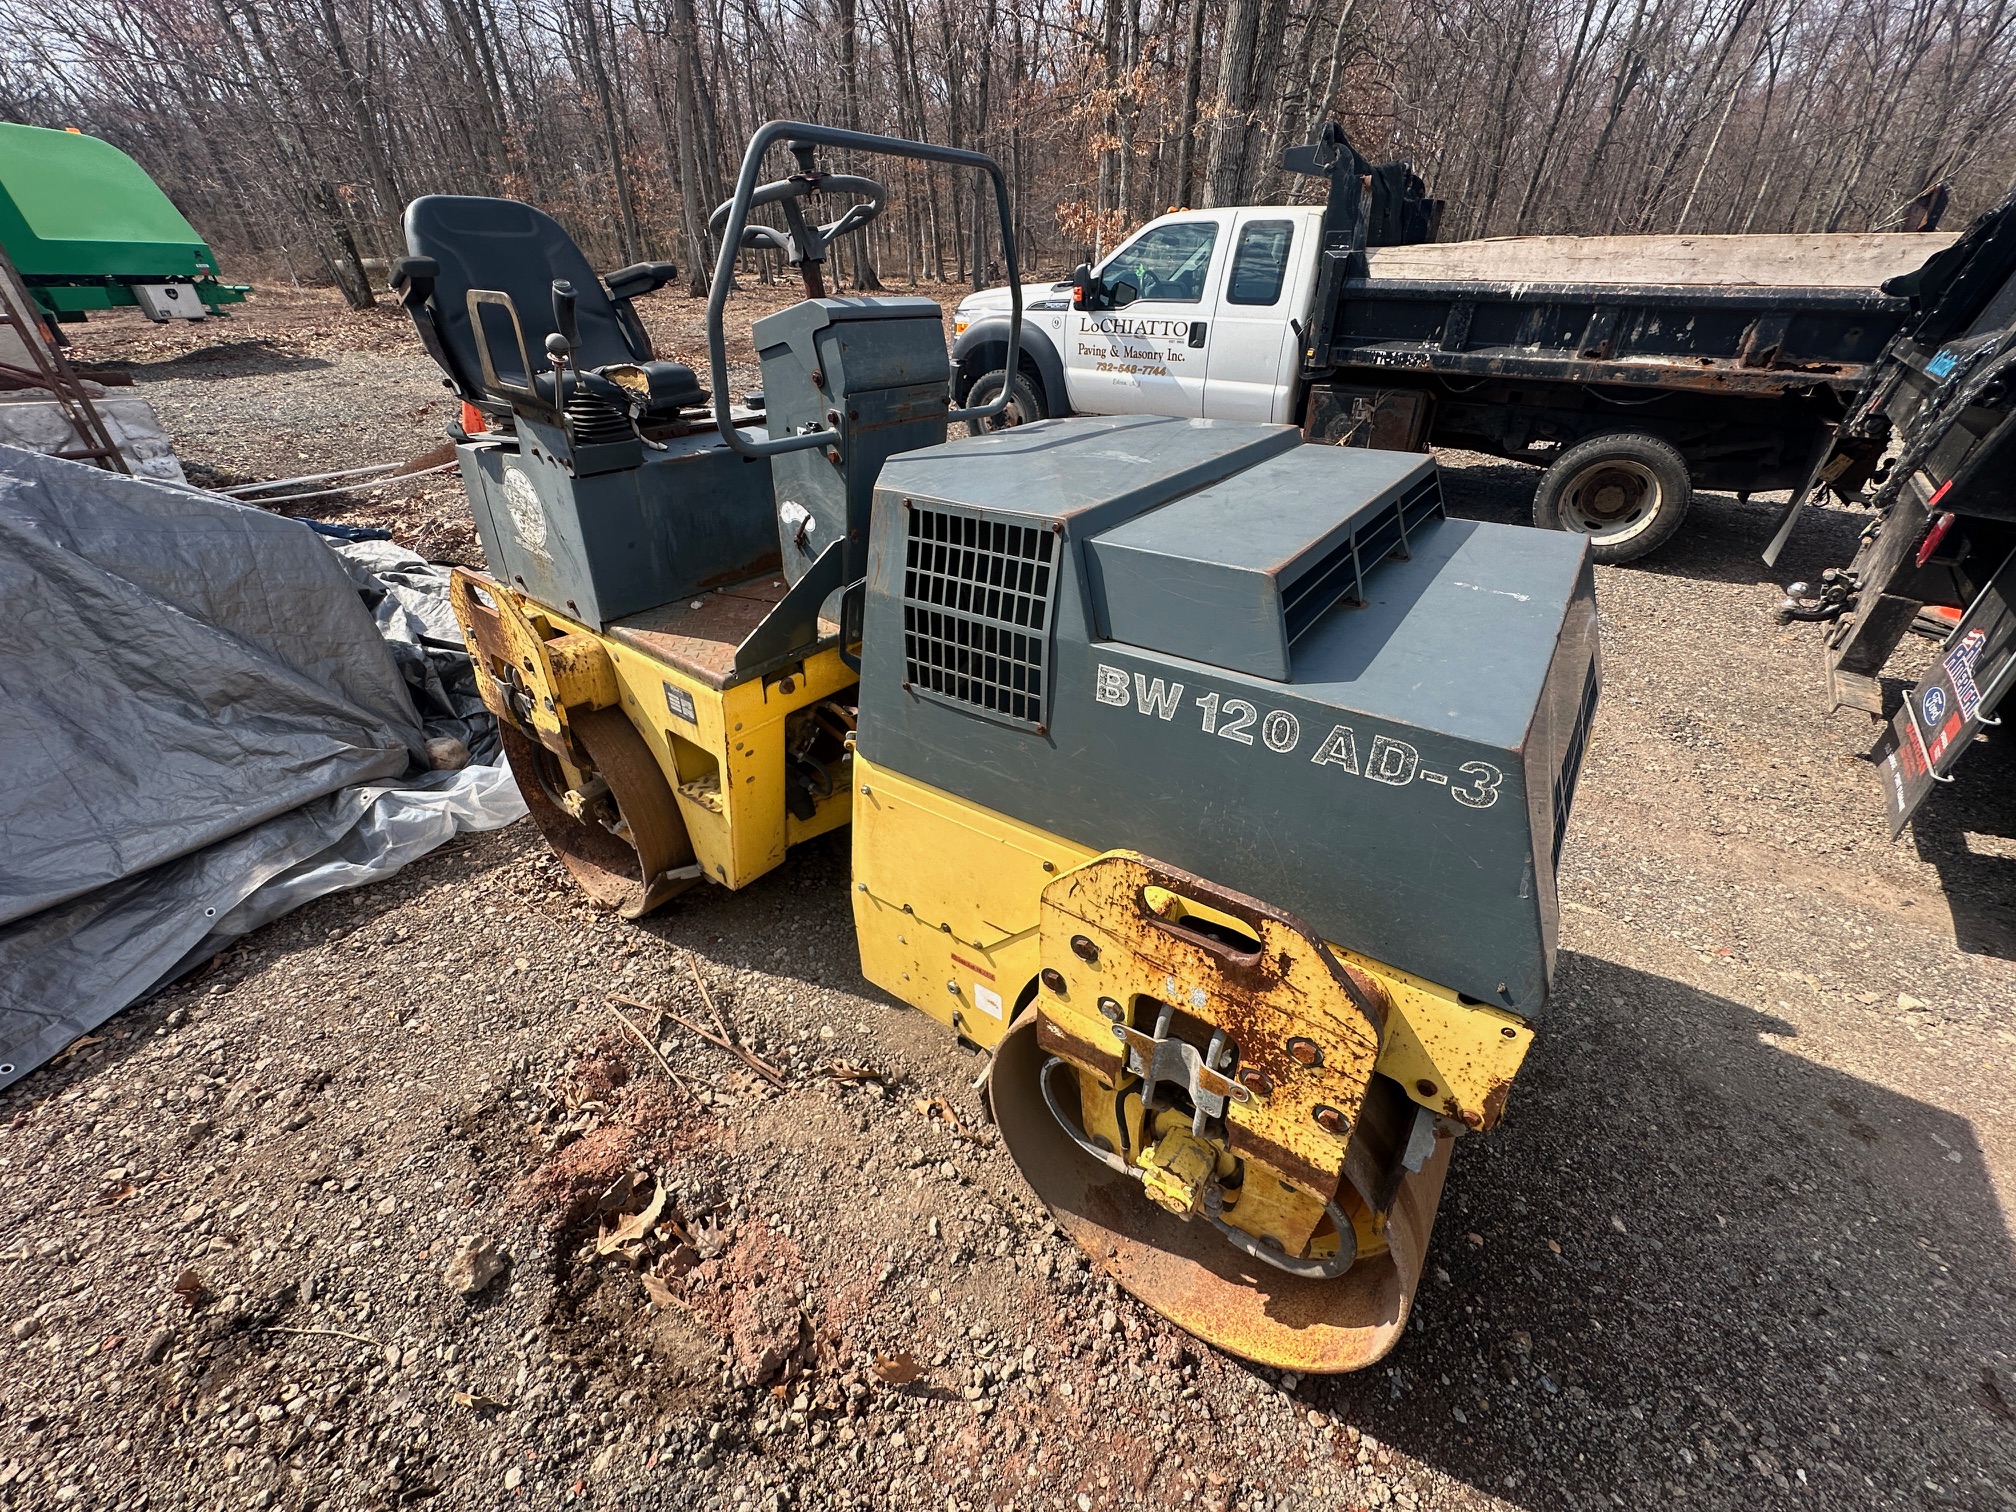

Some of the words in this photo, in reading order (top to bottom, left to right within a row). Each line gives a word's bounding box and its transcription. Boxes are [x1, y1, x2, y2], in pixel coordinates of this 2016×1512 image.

[1080, 318, 1188, 337] LoCHIATTO
[1078, 343, 1107, 359] Paving
[1110, 345, 1120, 358] &
[1124, 346, 1164, 363] Masonry
[1167, 348, 1186, 362] Inc.
[1096, 362, 1167, 376] 732-548-7744
[1925, 691, 1942, 721] Ford
[1096, 664, 1185, 721] BW
[1196, 692, 1300, 753] 120
[1310, 724, 1503, 809] AD-3
